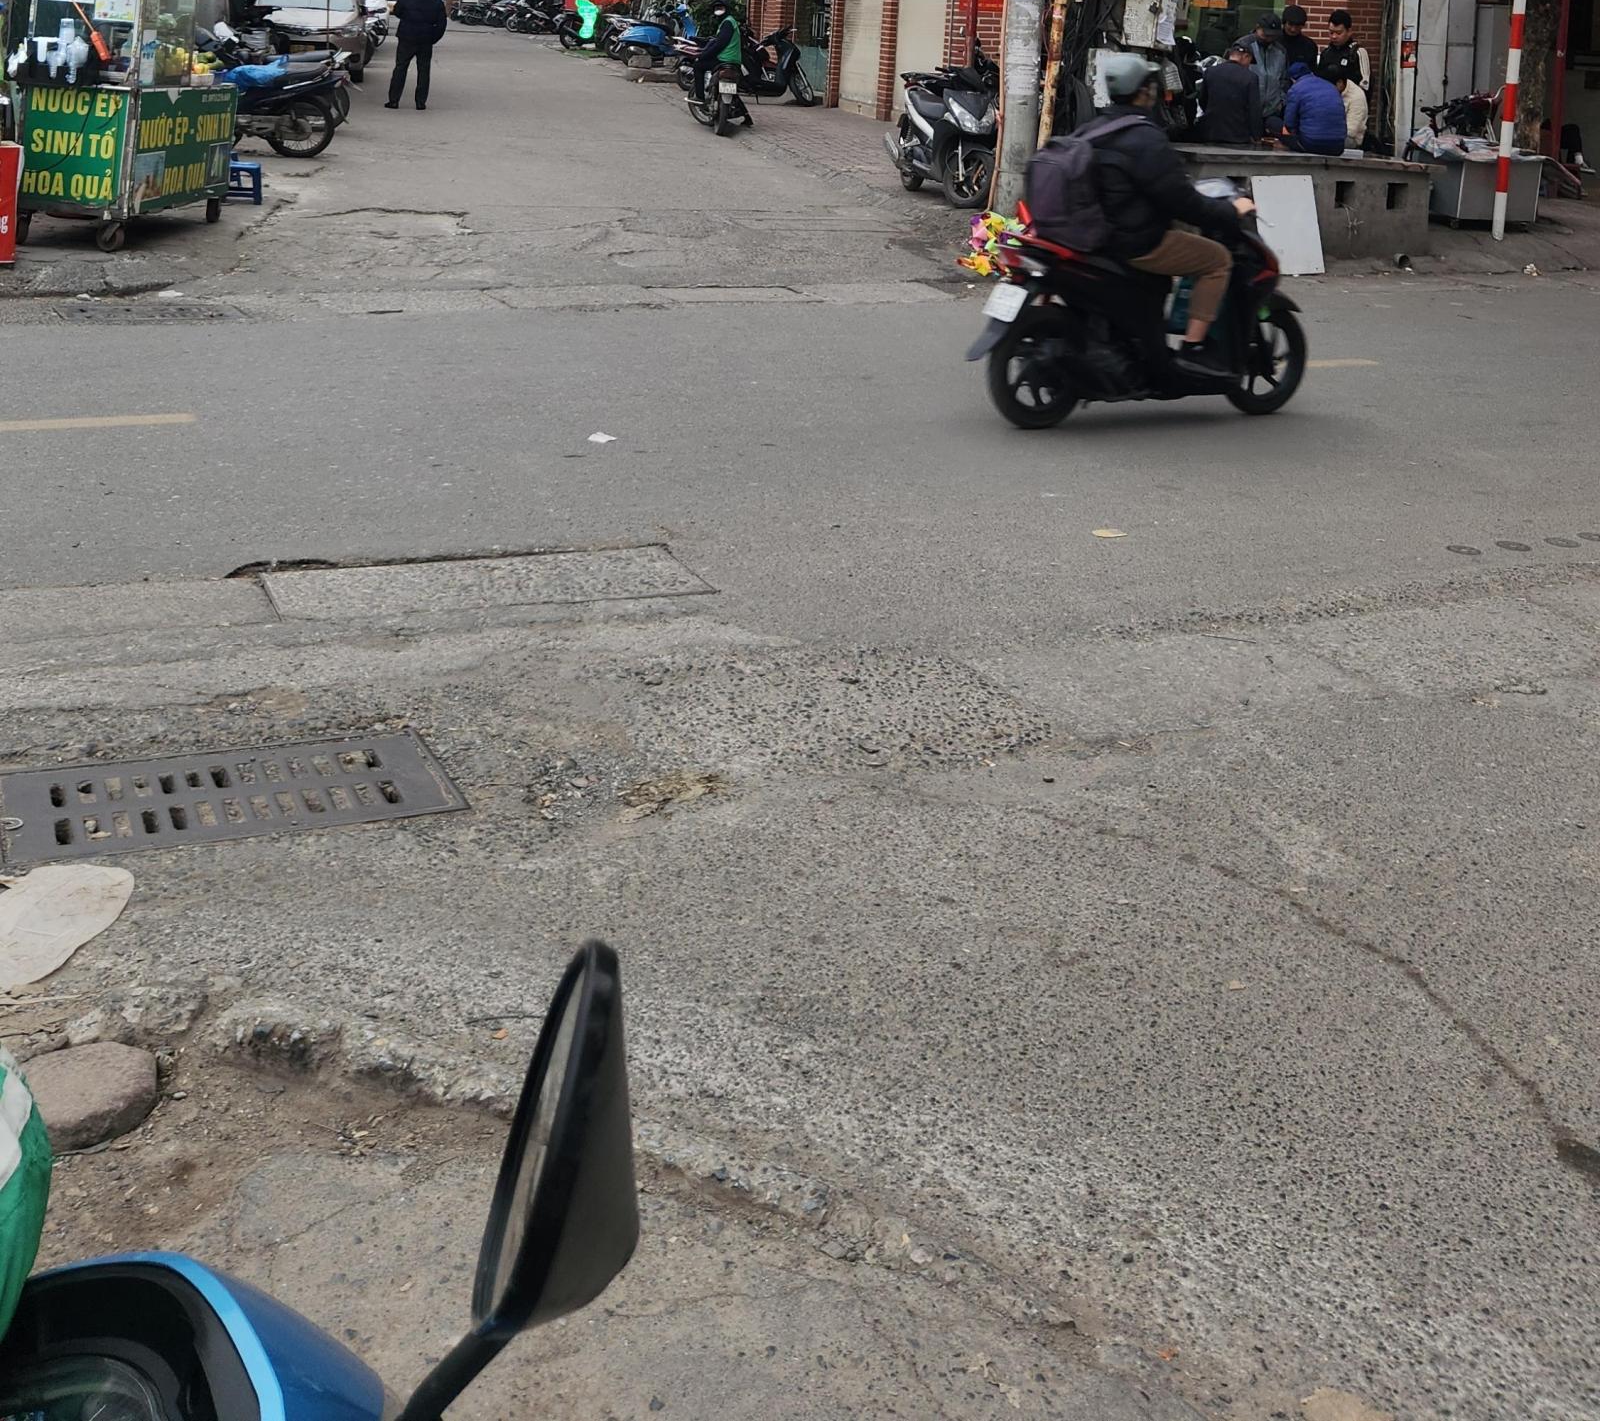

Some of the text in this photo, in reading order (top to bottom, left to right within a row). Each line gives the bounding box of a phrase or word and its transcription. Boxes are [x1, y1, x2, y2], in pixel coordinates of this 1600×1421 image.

[31, 86, 123, 117] NƯỚC ÉP
[139, 112, 173, 149] NƯỚC
[174, 111, 189, 145] ÉP
[196, 113, 219, 142] SINH
[220, 103, 232, 139] TỐ
[31, 127, 117, 159] SINH TỐ
[22, 169, 113, 201] HOA QUẢ
[161, 165, 185, 196] HOA
